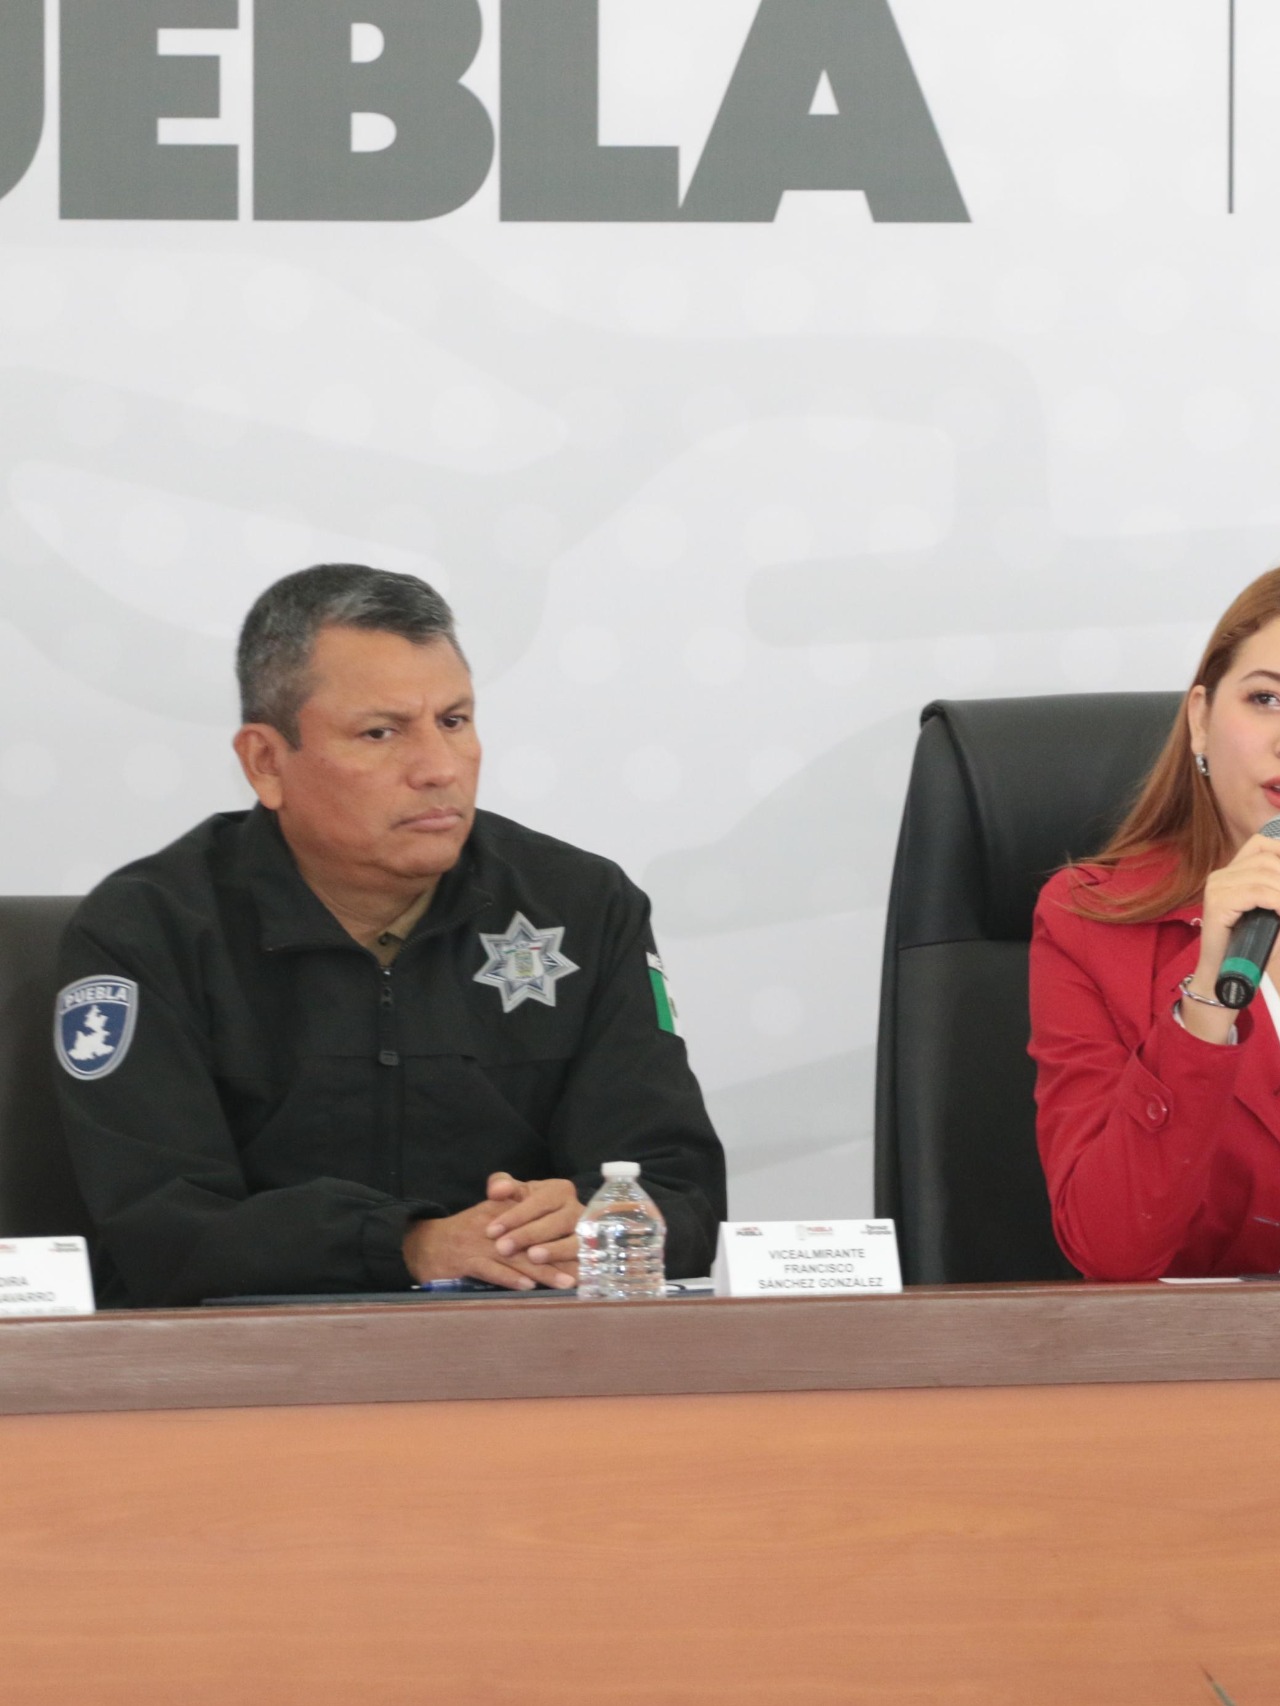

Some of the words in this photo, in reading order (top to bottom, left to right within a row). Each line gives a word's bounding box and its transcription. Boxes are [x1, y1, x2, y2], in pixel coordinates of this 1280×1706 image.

[0, 0, 971, 222] EBLA
[64, 986, 128, 1008] PUEBLA
[768, 1249, 866, 1259] VICEALMIRANTE
[784, 1263, 853, 1274] FRANCISCO
[758, 1277, 814, 1289] SÁNCHEZ
[819, 1276, 883, 1288] GONZÁLEZ
